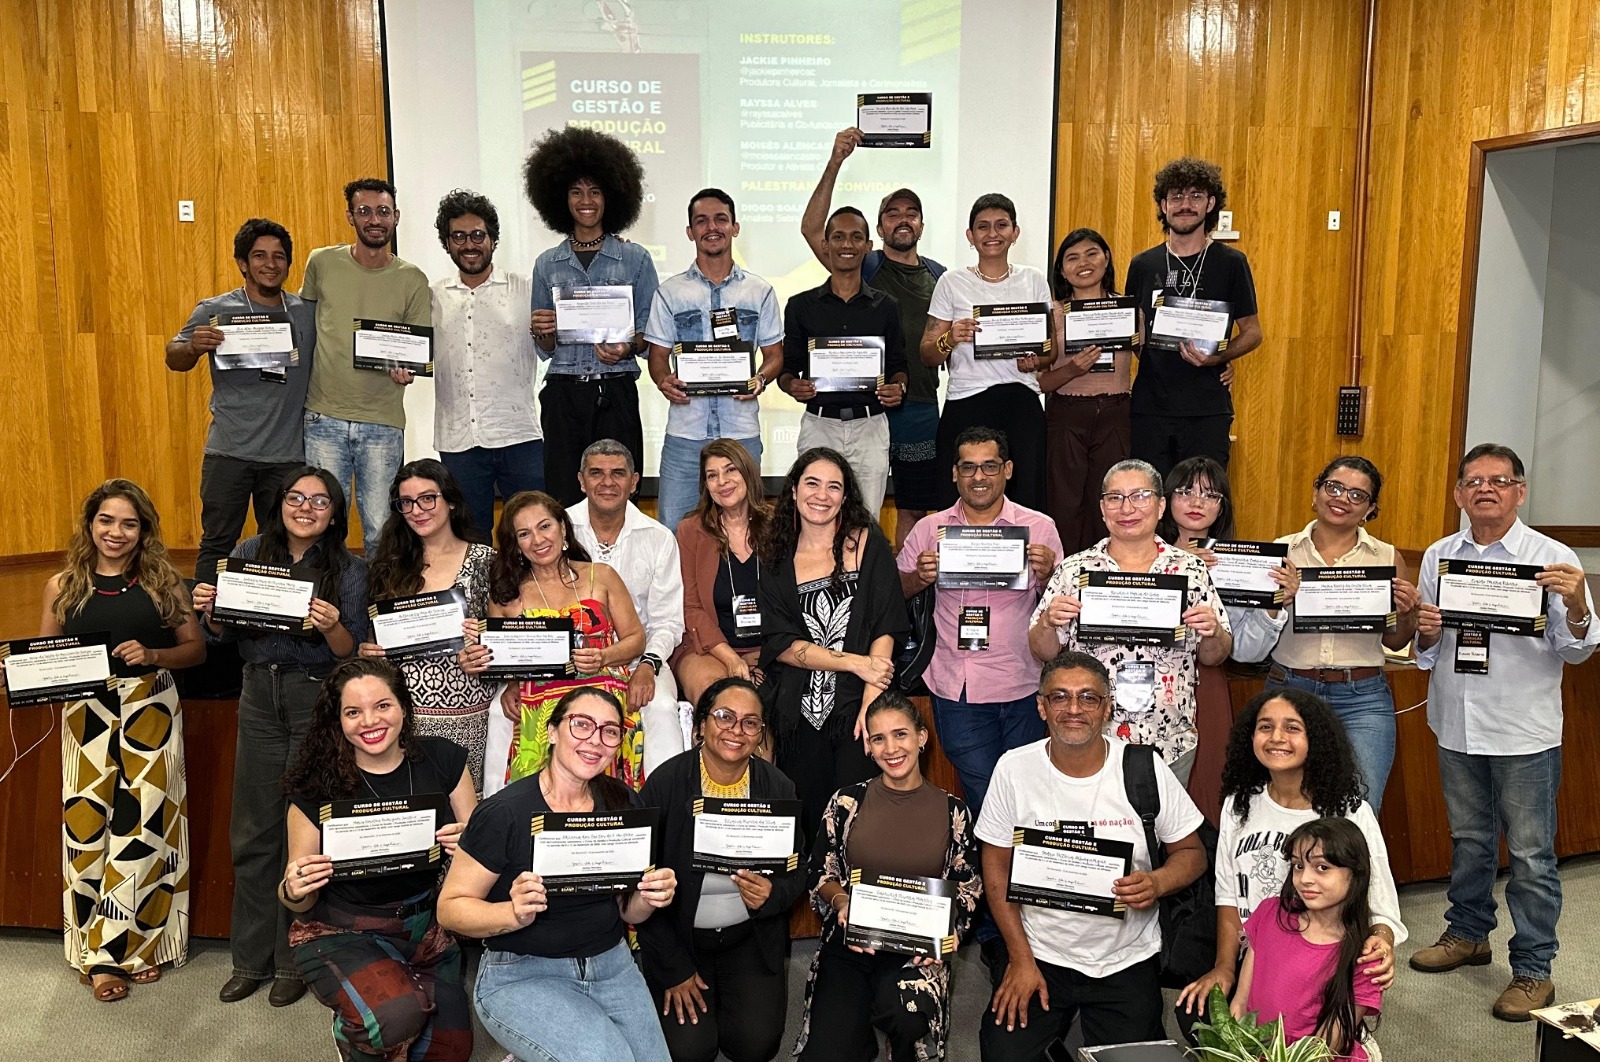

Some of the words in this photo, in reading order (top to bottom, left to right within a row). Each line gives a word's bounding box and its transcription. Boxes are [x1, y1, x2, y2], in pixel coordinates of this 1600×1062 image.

[740, 34, 836, 45] INSTRUTORES:
[740, 56, 778, 65] JACKIE
[781, 57, 831, 66] PINHEIRO
[570, 80, 632, 94] CURSO
[638, 81, 662, 94] DE
[572, 98, 644, 113] GESTÃO
[651, 101, 662, 114] E
[742, 181, 815, 191] PALESTRAN
[1235, 831, 1271, 859] LOLA
